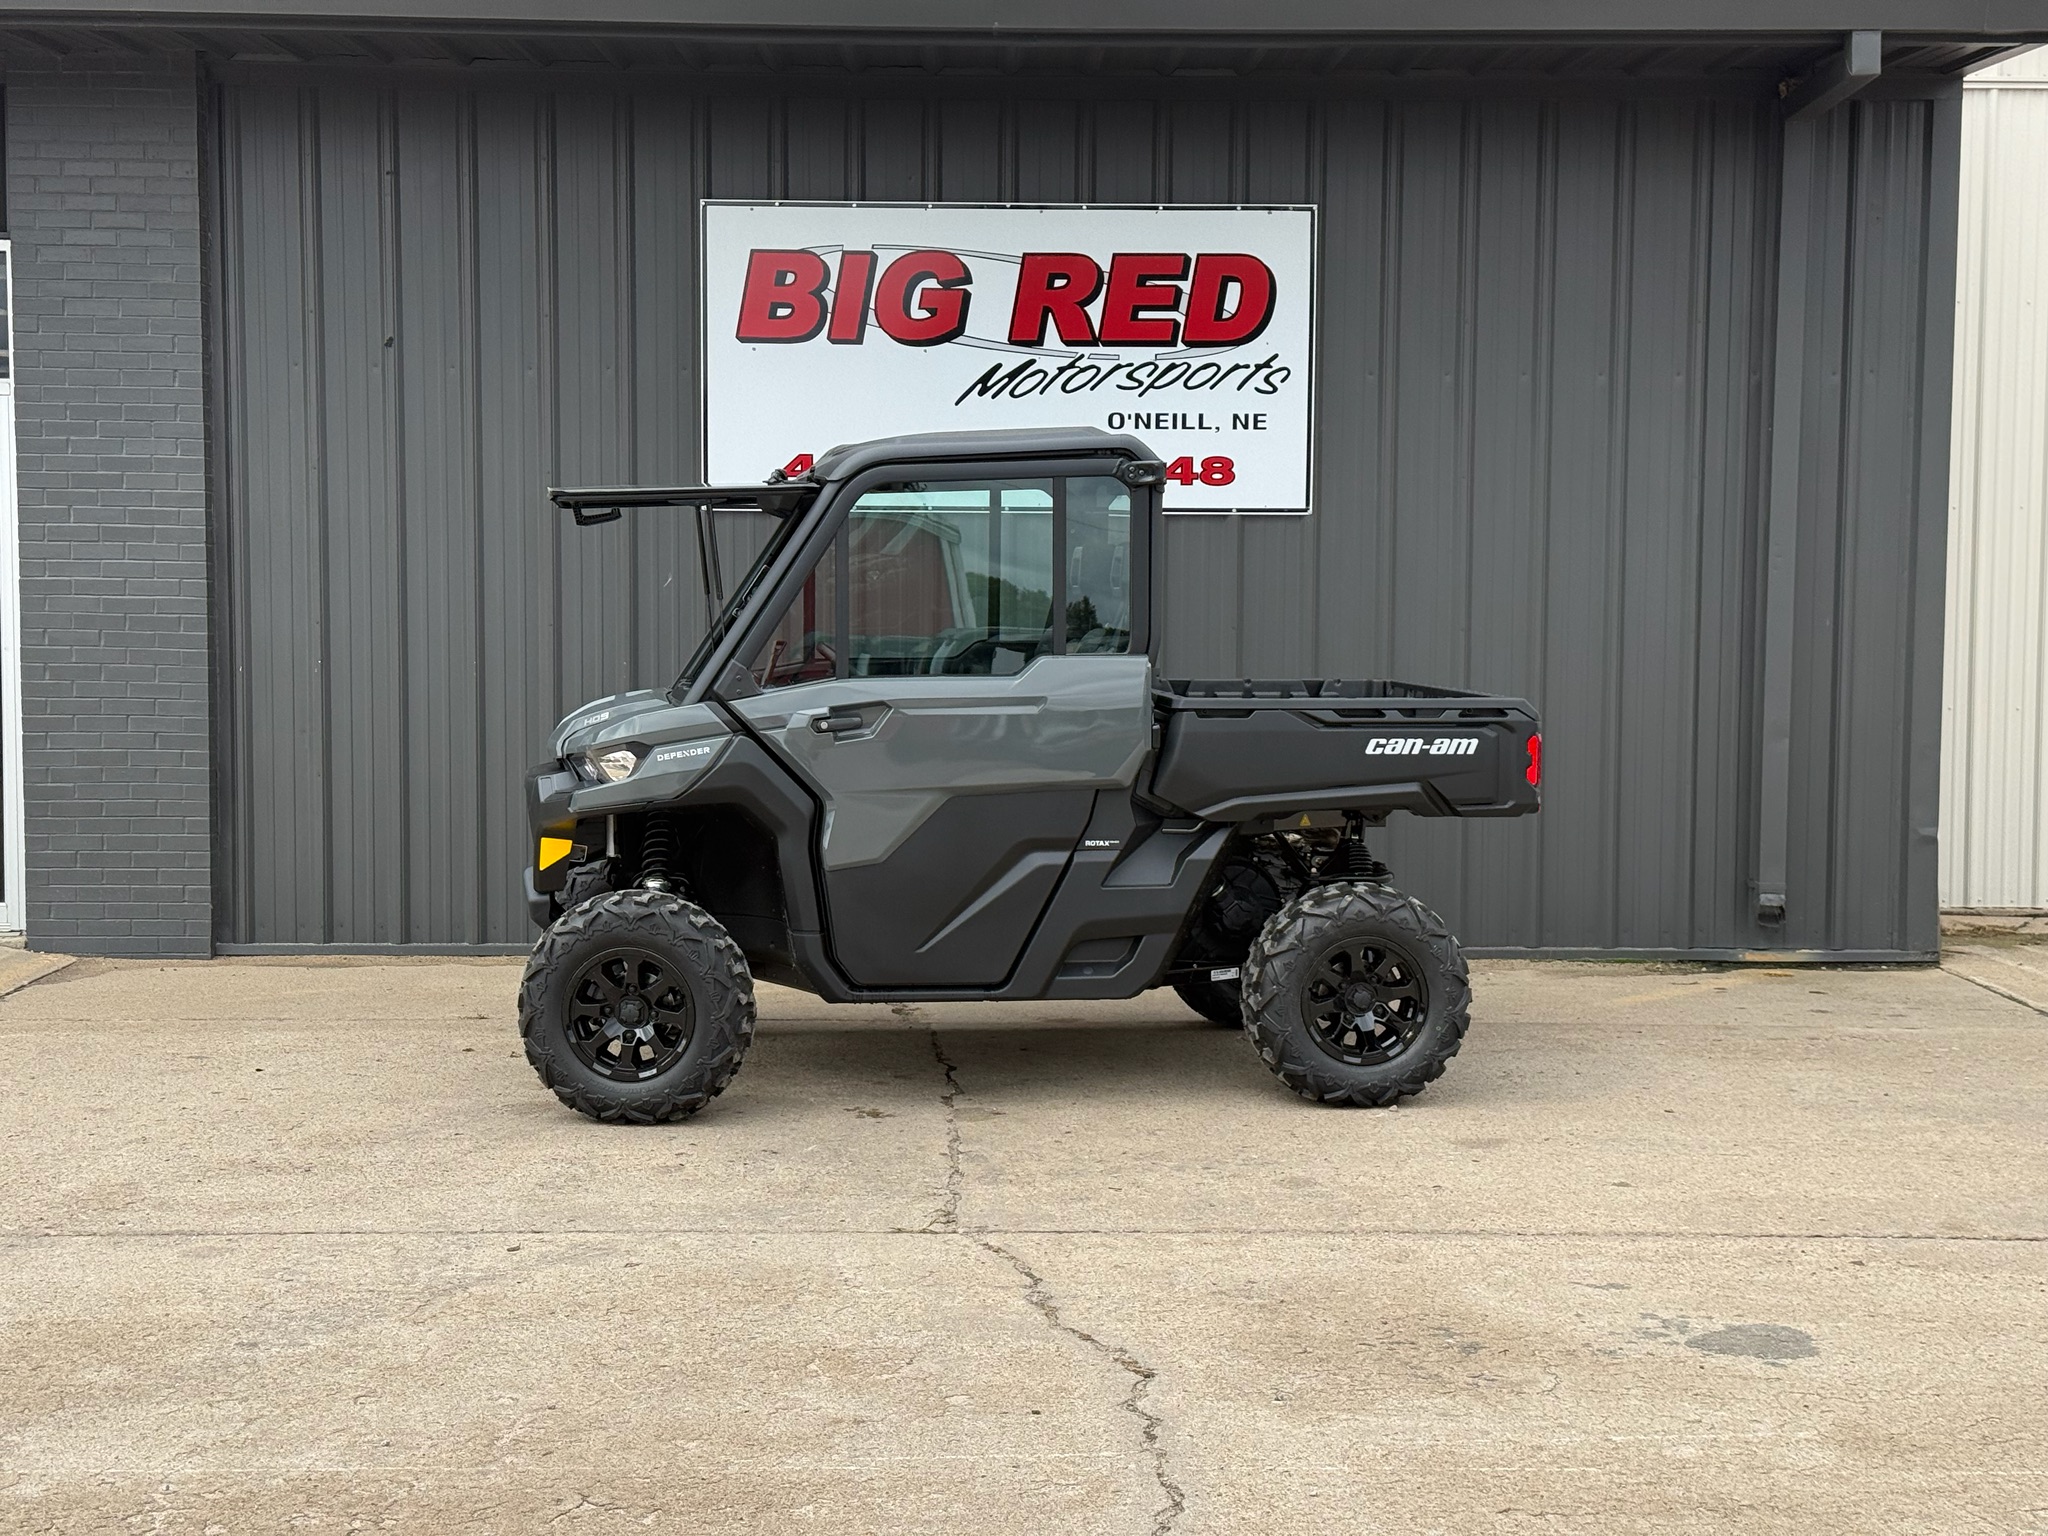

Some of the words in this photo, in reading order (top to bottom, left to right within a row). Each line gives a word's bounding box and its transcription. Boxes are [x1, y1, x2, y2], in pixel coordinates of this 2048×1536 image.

[735, 249, 972, 346] BIG
[1008, 252, 1278, 348] RED
[954, 353, 1291, 407] Motorsports
[1107, 412, 1220, 433] O'NEILL,
[1232, 413, 1267, 430] NE
[656, 746, 711, 762] DEFENDER
[1365, 738, 1479, 755] can-am
